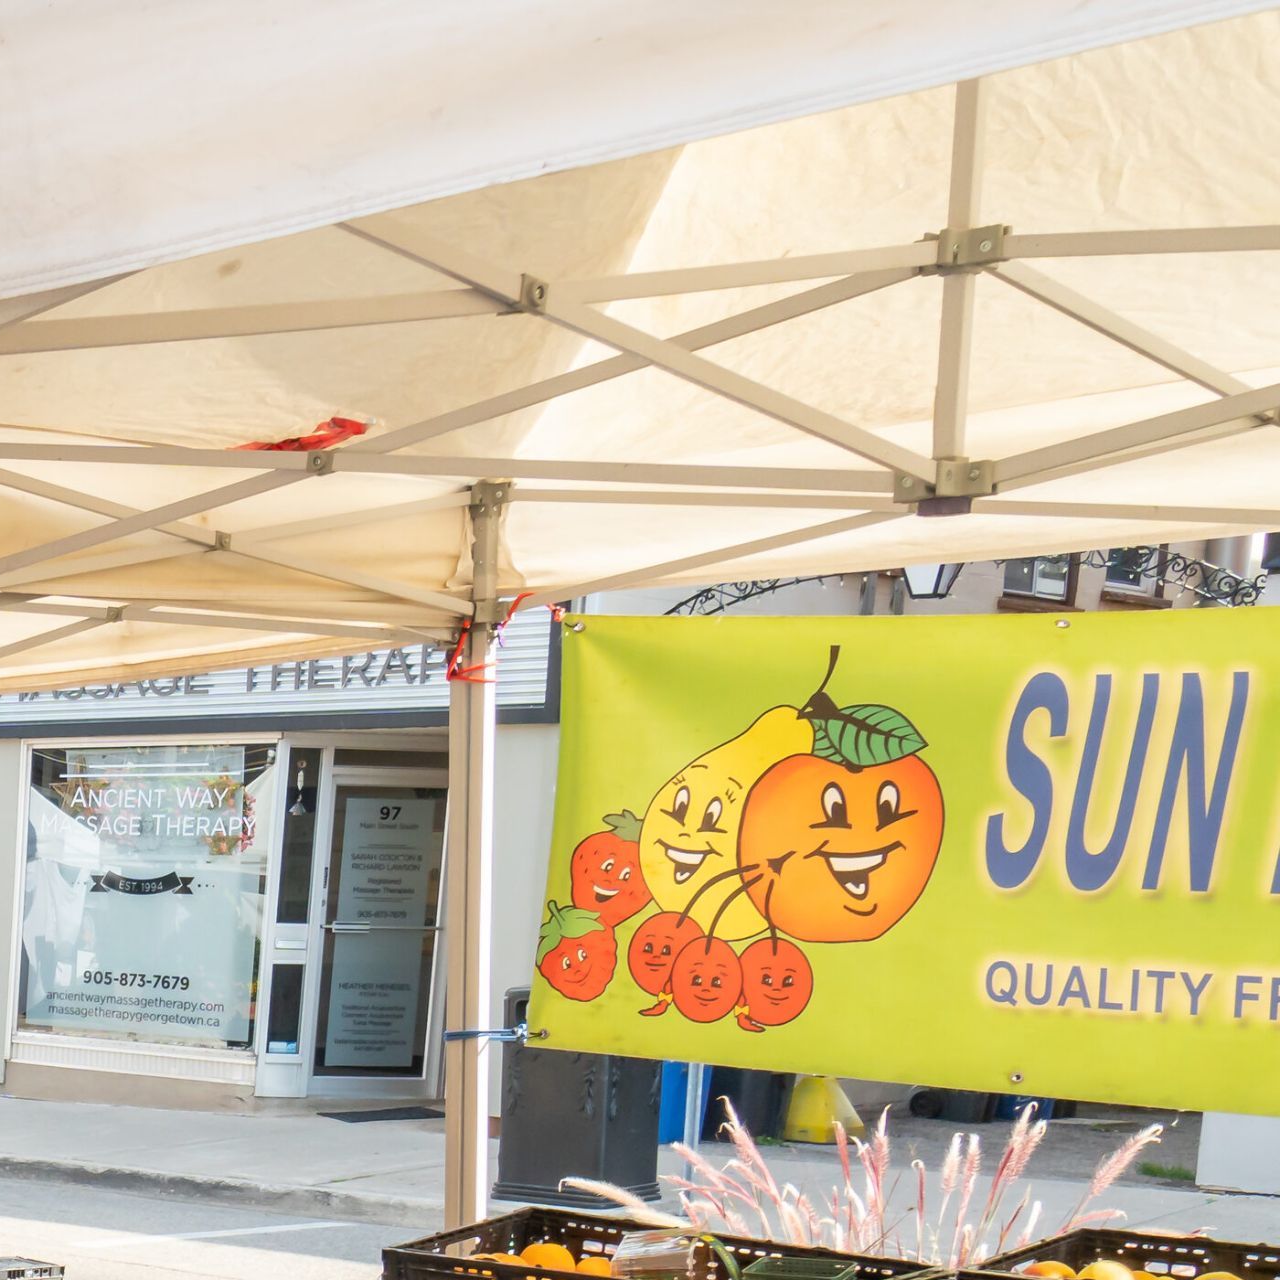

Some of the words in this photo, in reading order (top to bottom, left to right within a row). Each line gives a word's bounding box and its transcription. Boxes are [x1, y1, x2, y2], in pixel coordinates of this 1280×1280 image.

[246, 643, 447, 692] THERAP
[985, 671, 1250, 892] SUN
[70, 786, 167, 809] ANCIENT
[175, 787, 229, 809] WAY
[380, 806, 402, 820] 97
[40, 813, 141, 836] MASSAGE
[152, 813, 257, 837] THERAPY
[140, 880, 164, 892] 1994
[82, 970, 190, 991] 905-873-7679
[985, 960, 1213, 1016] QUALITY
[46, 990, 225, 1013] ancientwaymassagetherapy.com
[48, 1004, 220, 1028] massagetherapygeorgetown.ca
